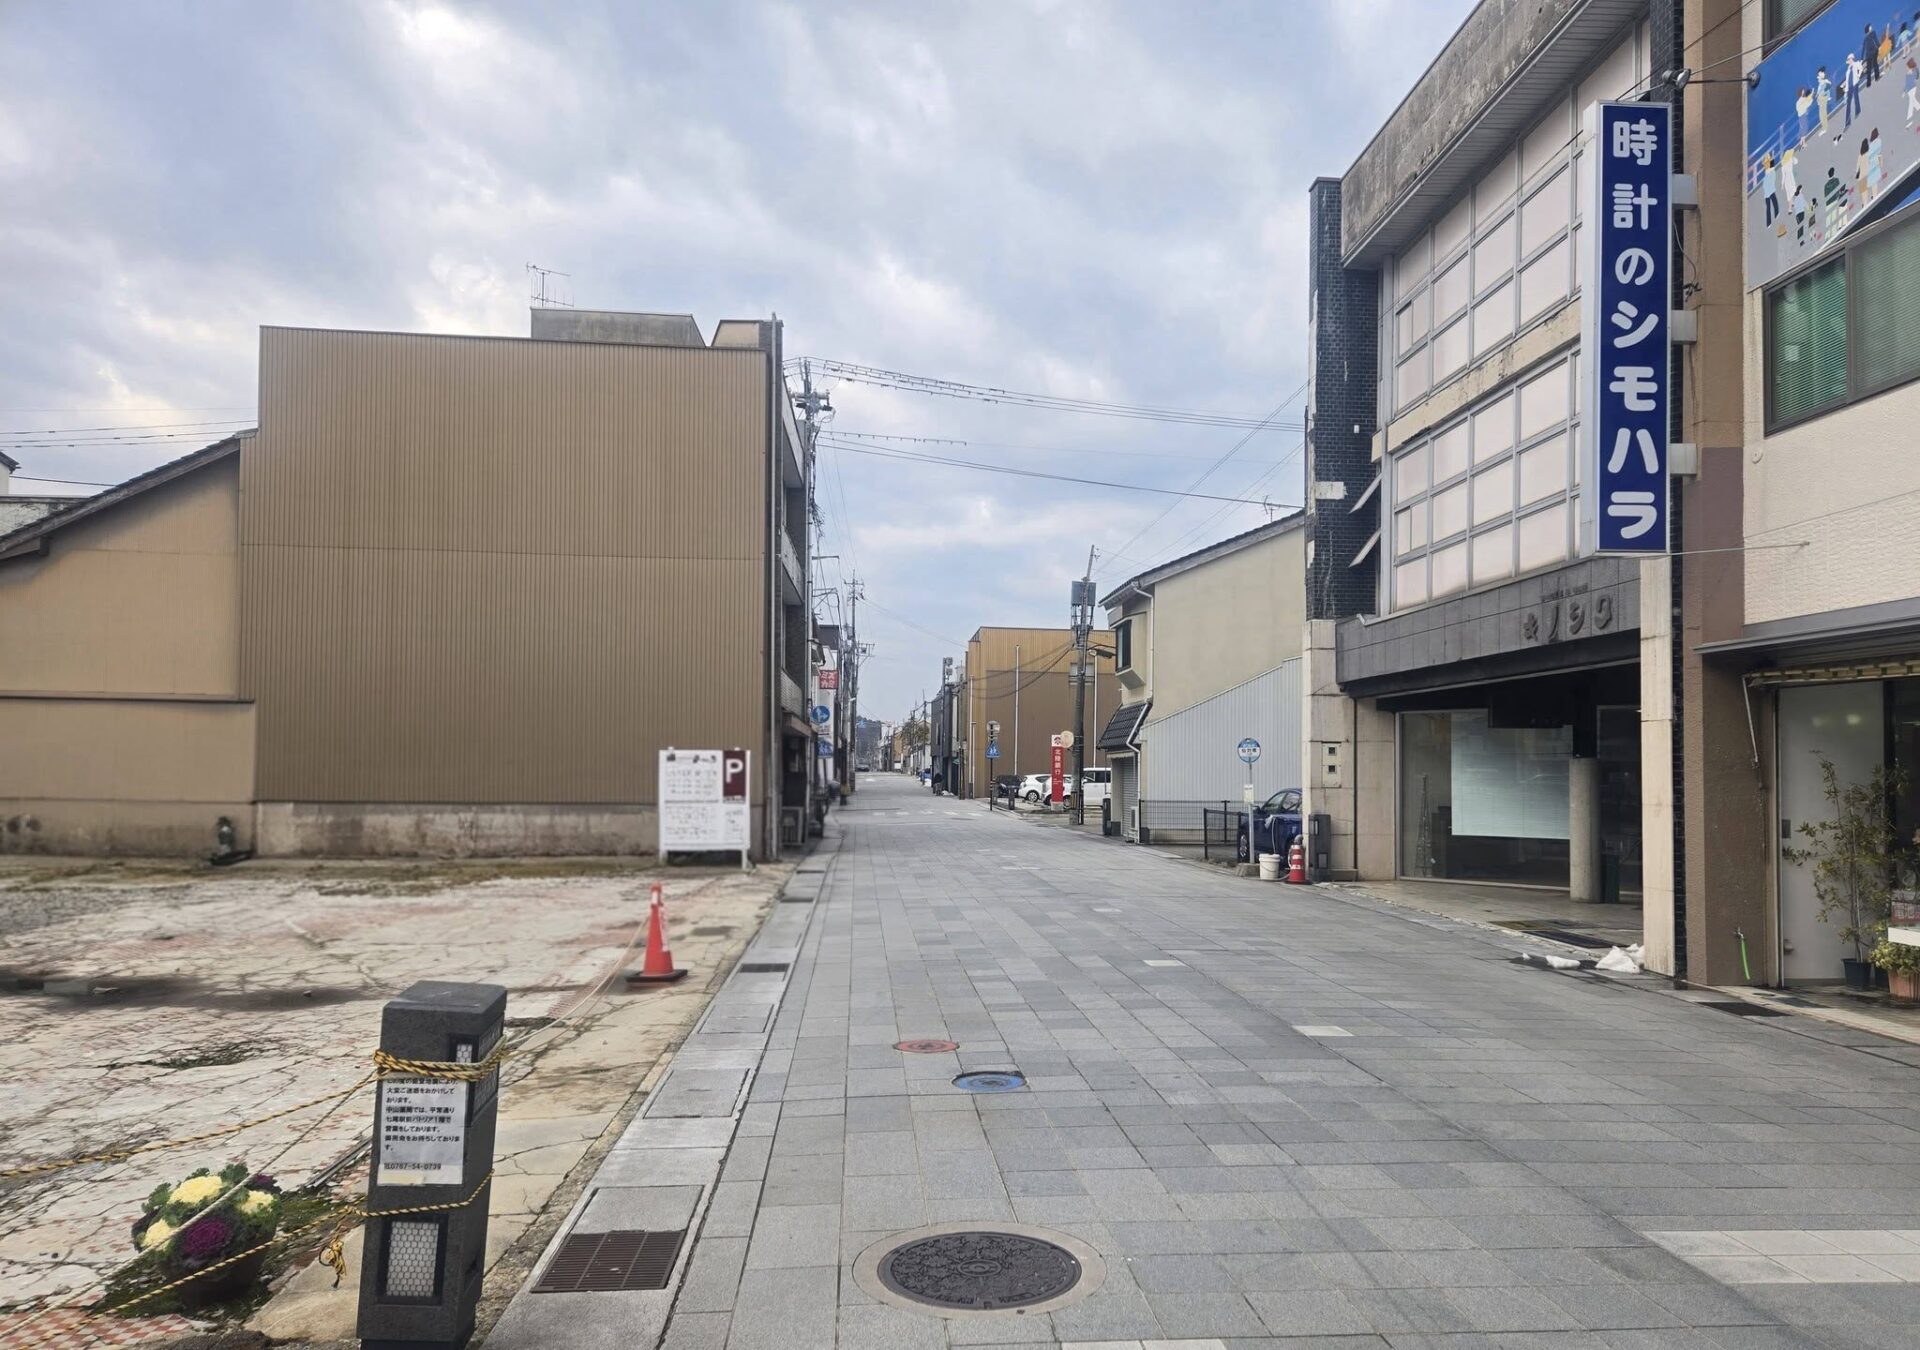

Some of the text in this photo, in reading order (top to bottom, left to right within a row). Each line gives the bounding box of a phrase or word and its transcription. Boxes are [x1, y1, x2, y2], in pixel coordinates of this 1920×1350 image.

[1607, 118, 1660, 540] 時計のシモハラ
[725, 759, 743, 783] P
